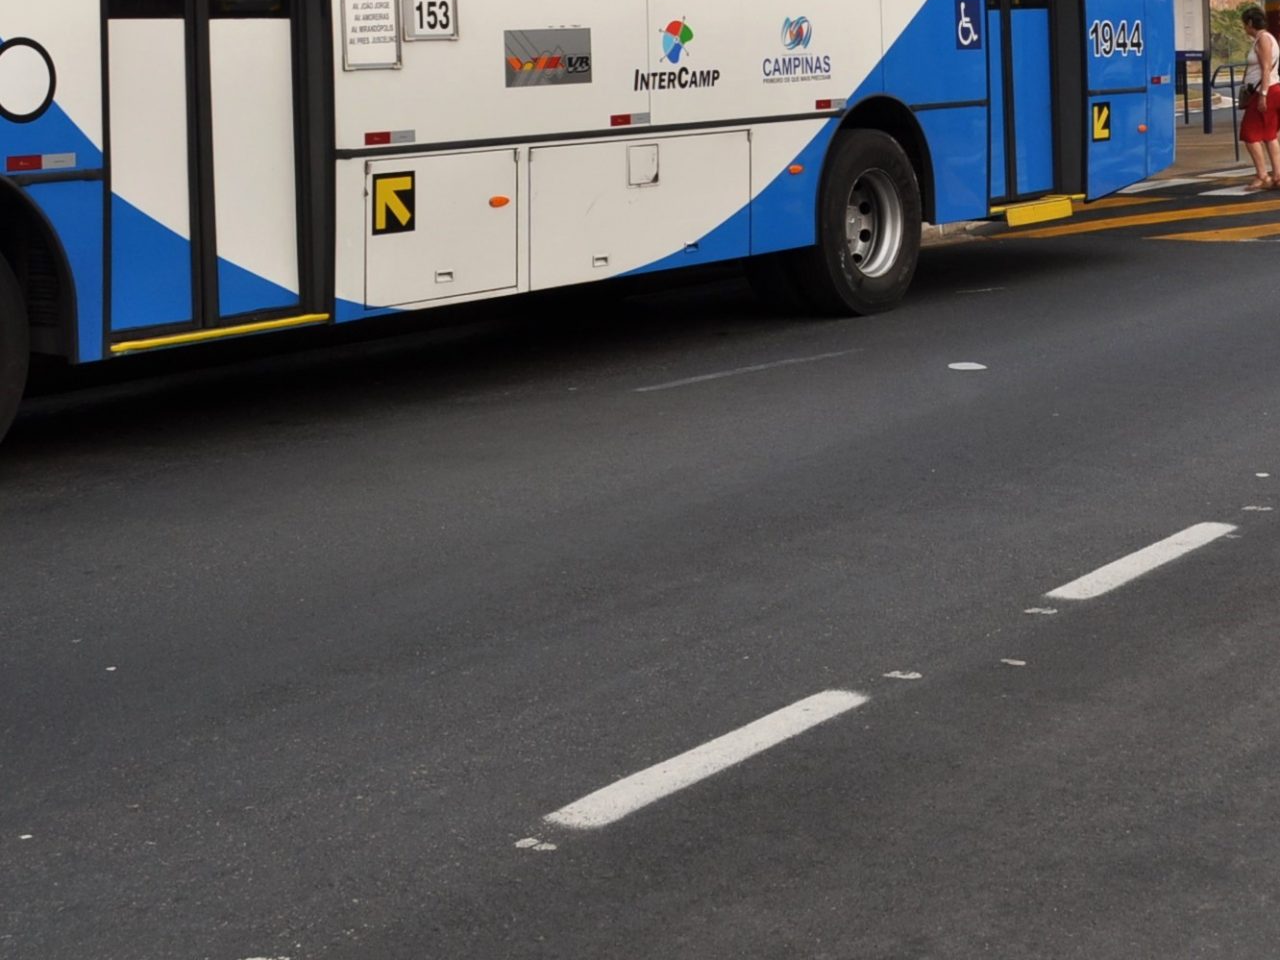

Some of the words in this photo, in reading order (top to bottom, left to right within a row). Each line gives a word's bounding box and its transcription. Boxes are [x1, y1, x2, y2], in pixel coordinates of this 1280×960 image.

[415, 0, 450, 30] 153
[1089, 20, 1144, 57] 1944
[762, 55, 831, 76] CAMPINAS
